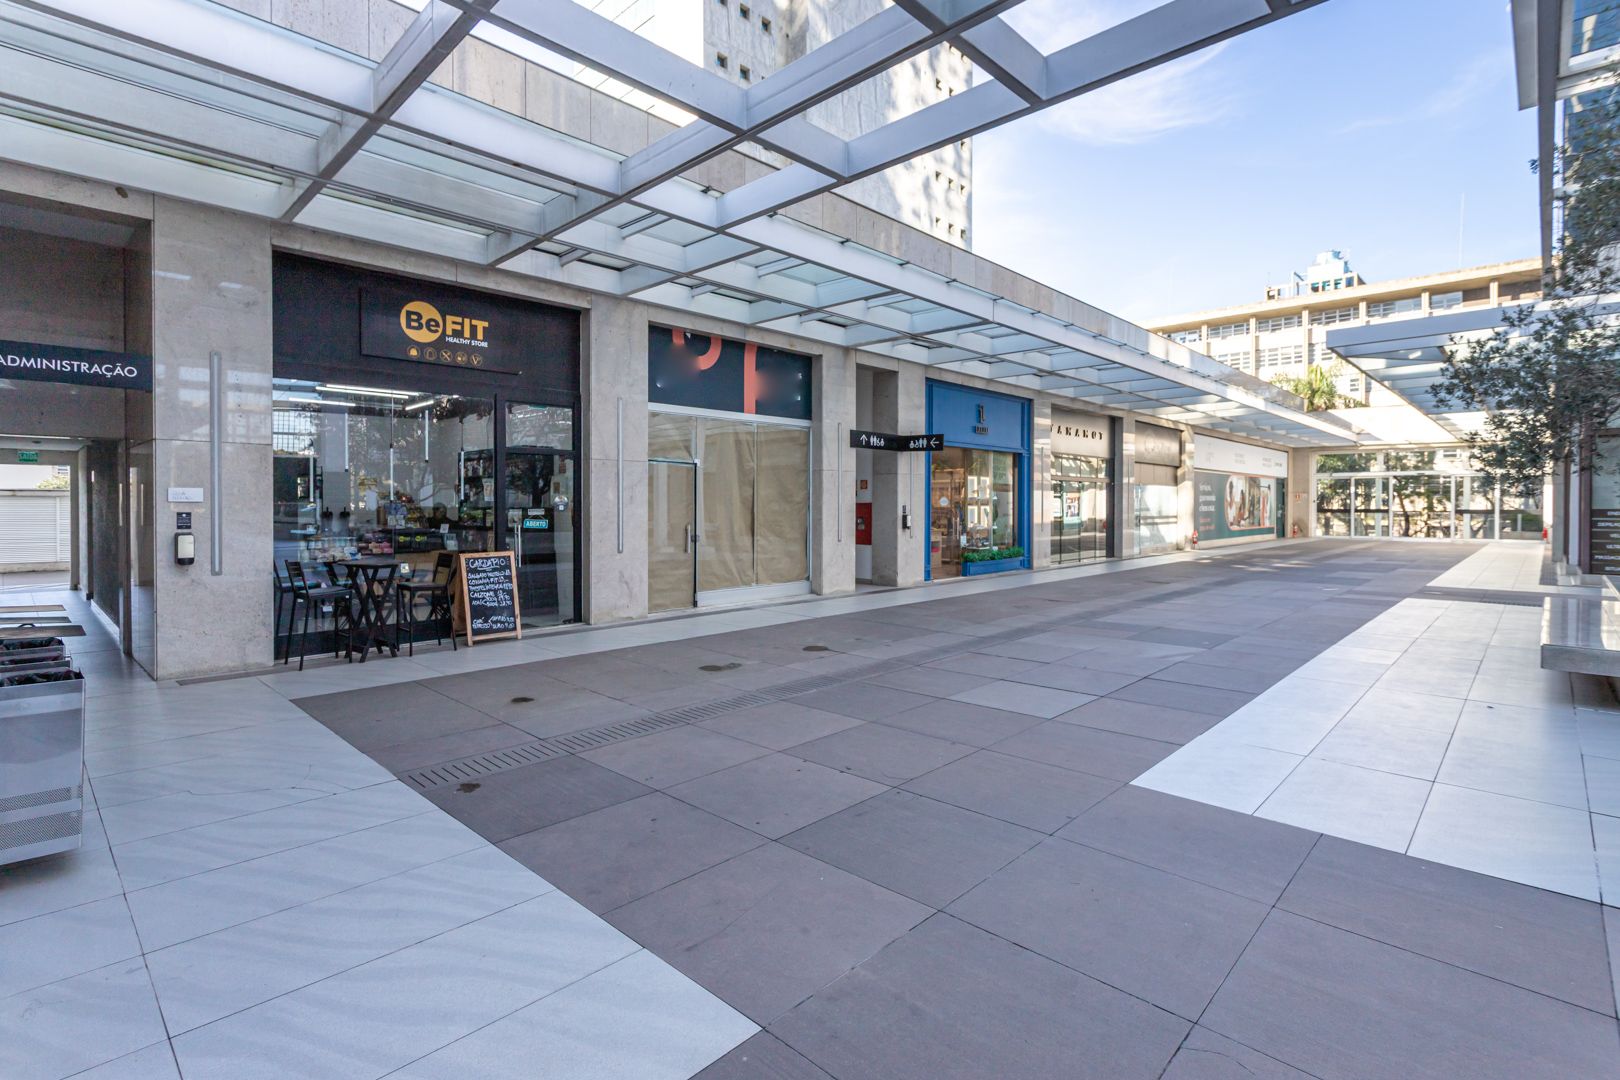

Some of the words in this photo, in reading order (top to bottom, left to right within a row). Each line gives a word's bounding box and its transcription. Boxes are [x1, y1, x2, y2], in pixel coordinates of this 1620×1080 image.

[446, 336, 471, 346] HEALTHY
[471, 340, 489, 348] STORE
[0, 354, 138, 378] ADMINISTRAÇÃO
